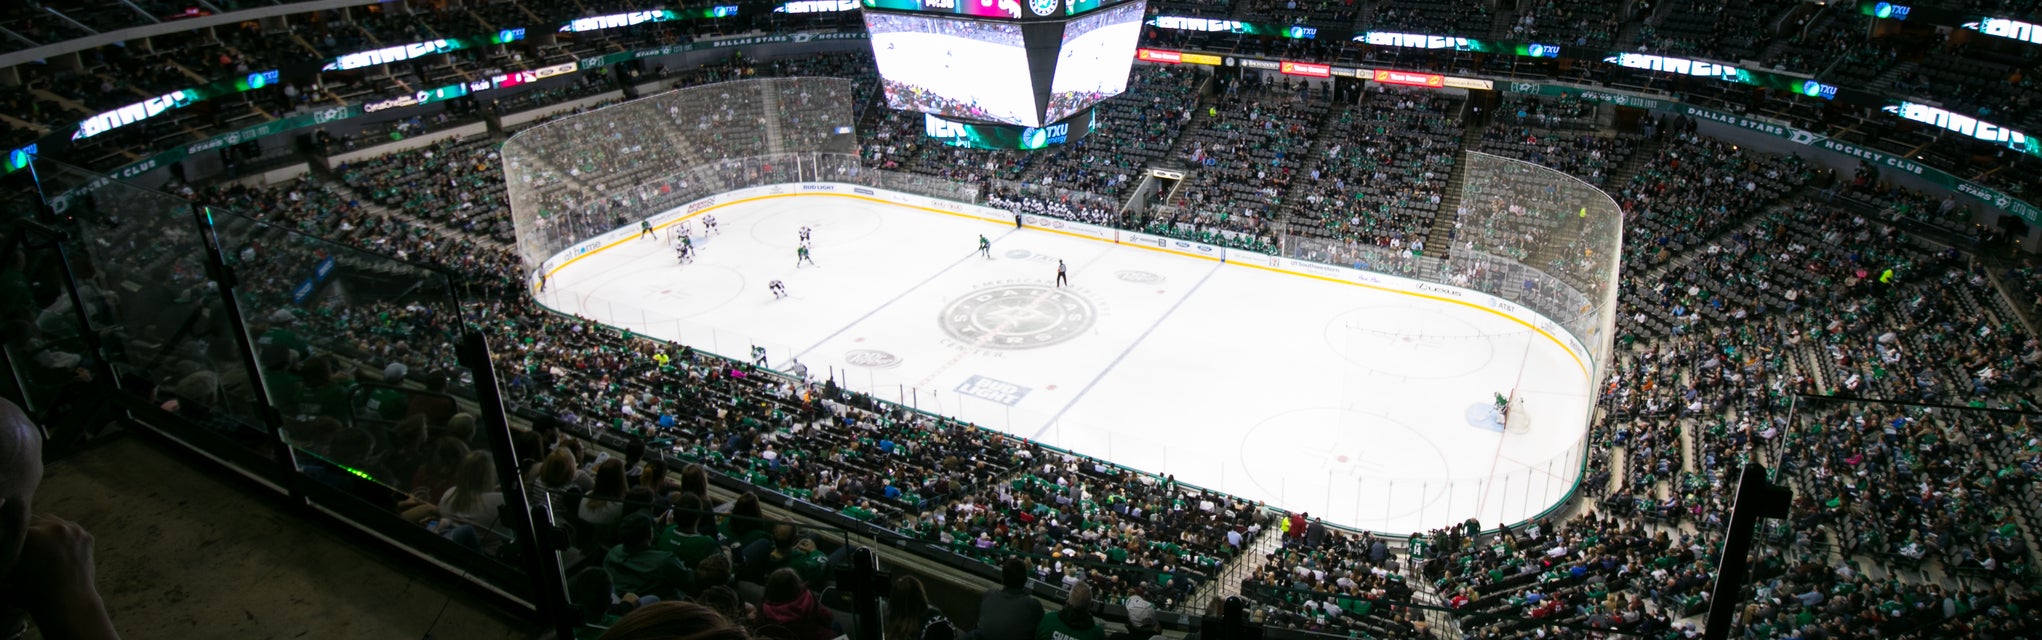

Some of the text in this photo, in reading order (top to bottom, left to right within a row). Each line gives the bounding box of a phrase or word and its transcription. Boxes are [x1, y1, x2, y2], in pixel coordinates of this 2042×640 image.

[1891, 4, 1911, 15] TXU
[1303, 27, 1317, 36] TXU
[713, 38, 752, 47] DALLAS
[755, 35, 787, 44] STARS
[818, 32, 857, 40] HOCKEY
[1543, 44, 1560, 54] TXU
[1820, 83, 1838, 95] TXU
[1046, 123, 1069, 138] TXU
[1047, 135, 1067, 145] energy
[1687, 107, 1924, 175] DALLAS STARS HOCKEY CLUB
[123, 159, 156, 179] CLUB
[1957, 184, 1993, 200] STARS
[1427, 286, 1462, 297] LEXUS
[976, 289, 1082, 321] DALLAS
[1498, 302, 1515, 312] AT&T
